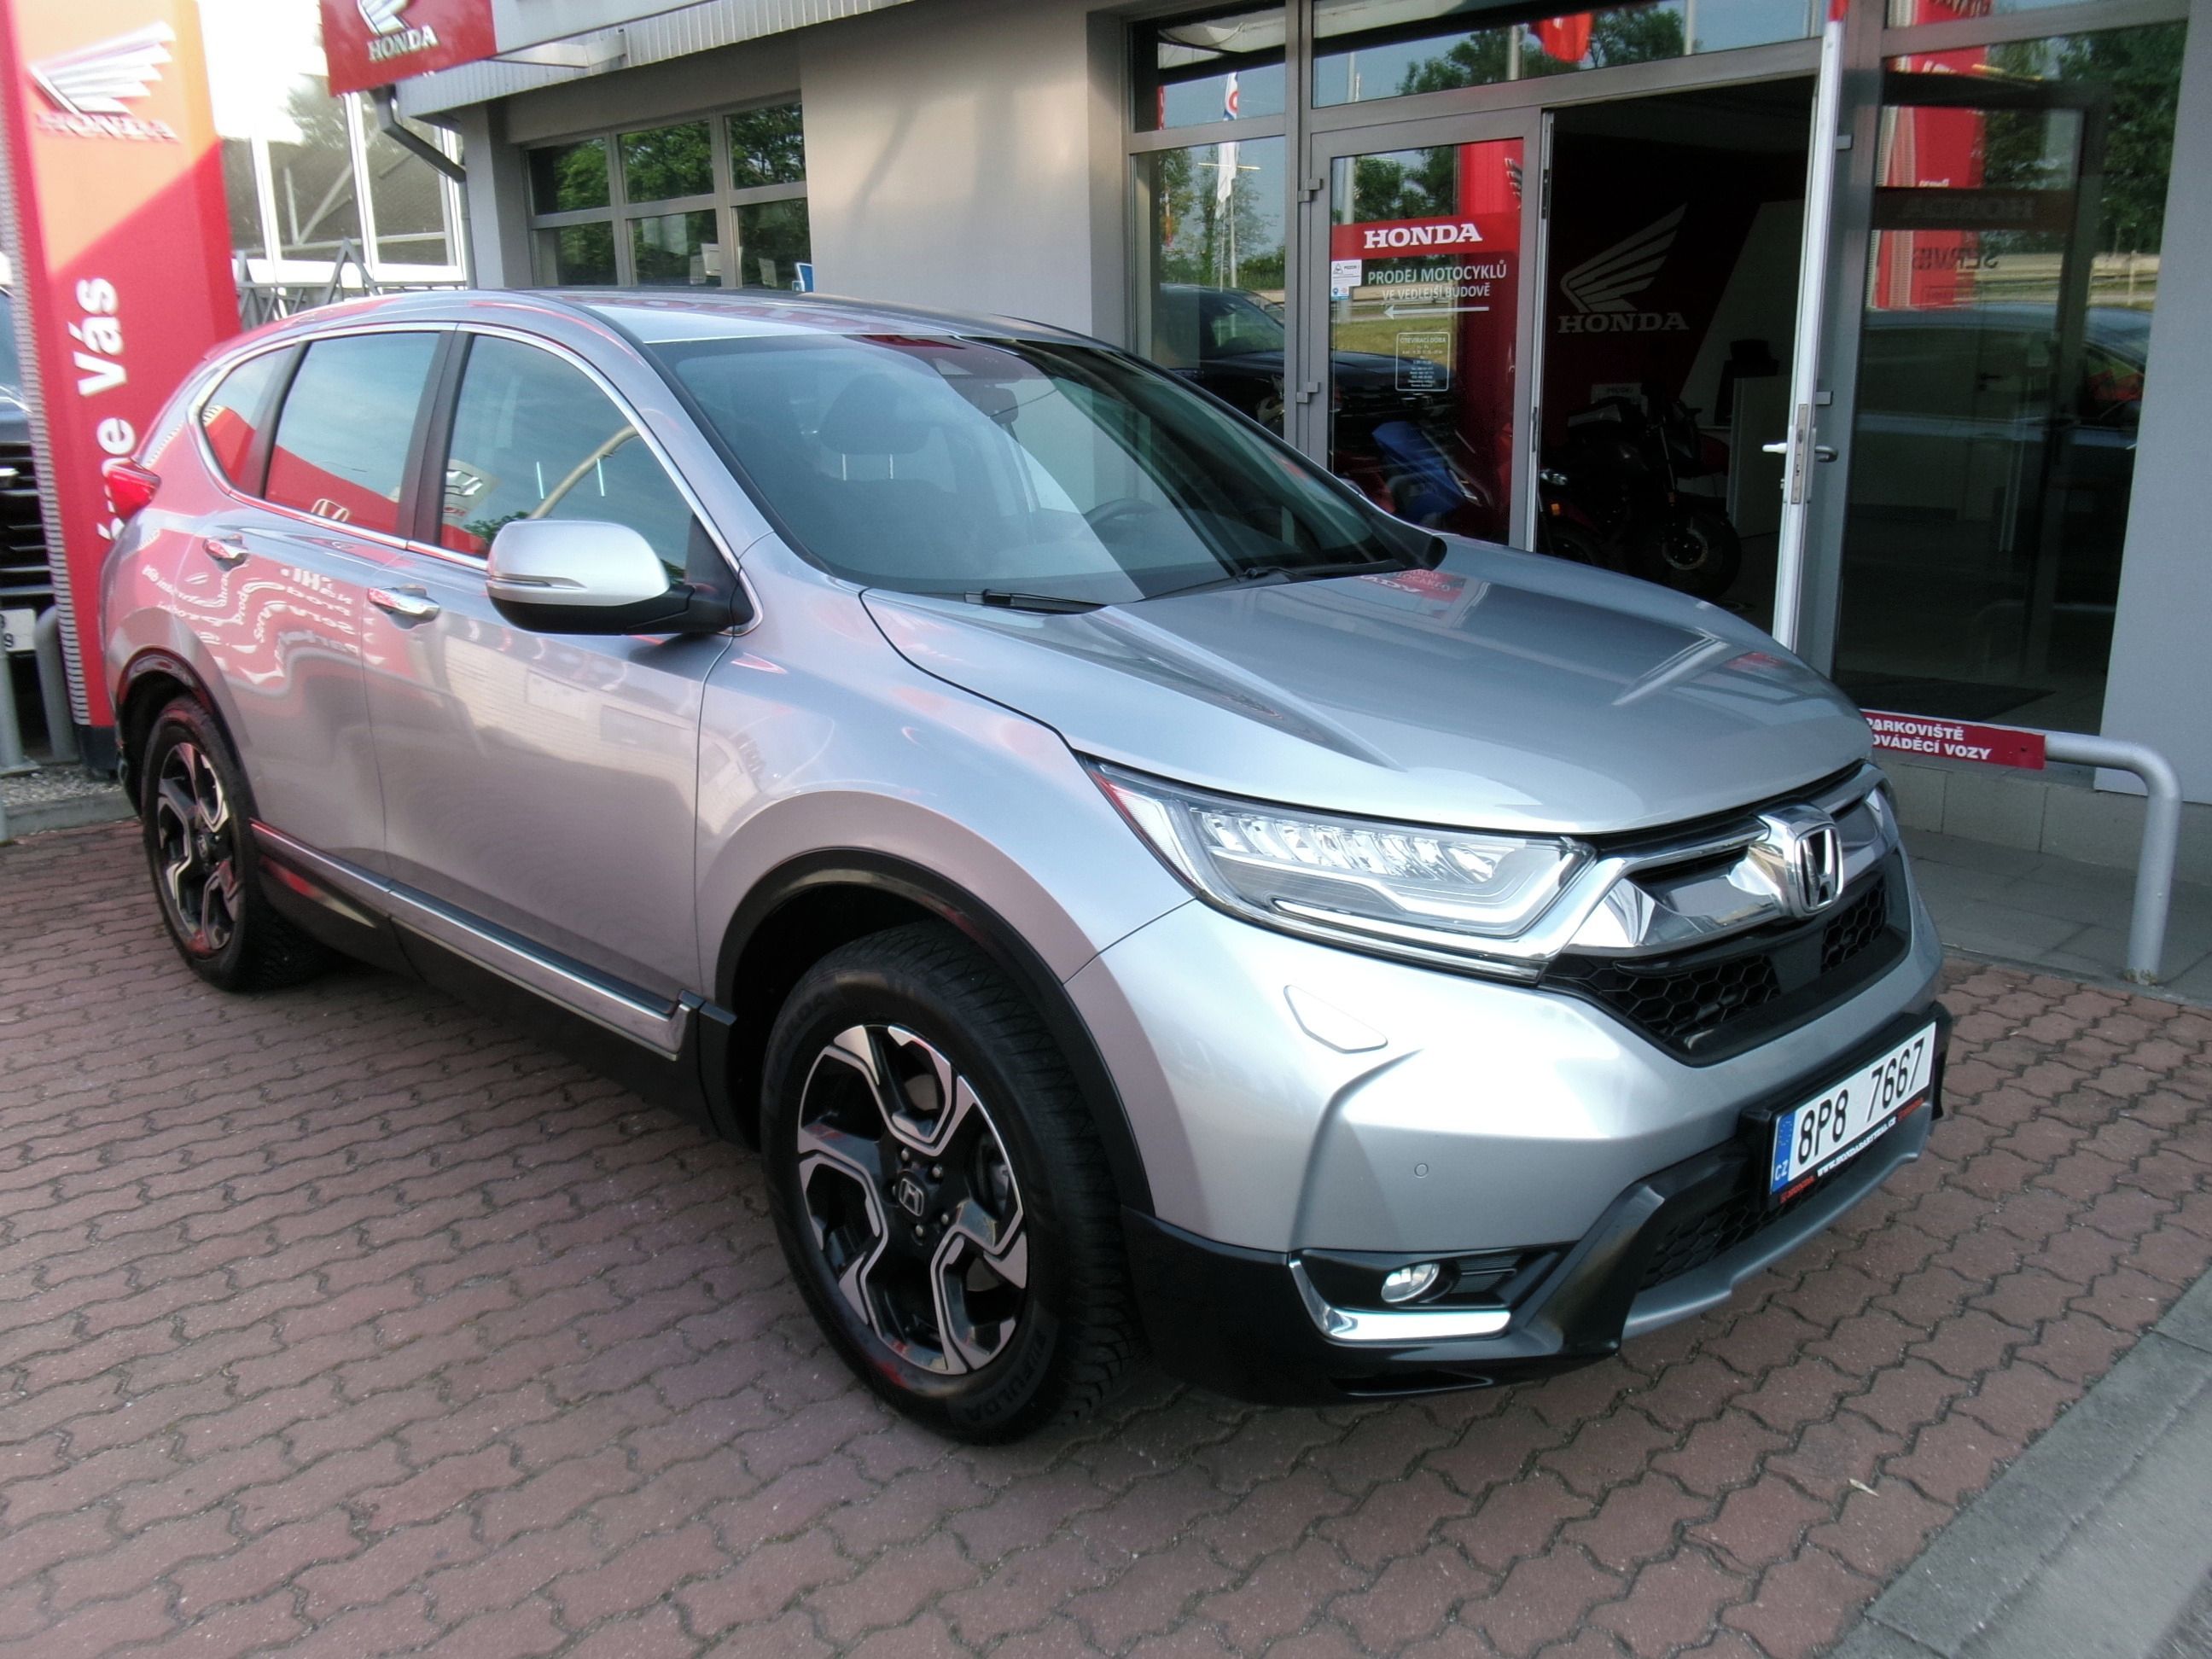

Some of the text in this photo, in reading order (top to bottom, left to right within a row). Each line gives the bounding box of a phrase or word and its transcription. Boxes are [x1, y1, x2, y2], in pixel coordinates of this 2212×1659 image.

[367, 25, 440, 62] HONDA
[1363, 223, 1483, 249] HONDA
[1368, 268, 1417, 285] PRODEJ
[1421, 259, 1507, 282] MOTOCYKLŮ
[1382, 288, 1395, 300] VE
[1446, 282, 1490, 297] BUDOVĚ
[1557, 312, 1690, 334] HONDA
[68, 277, 127, 397] Vás
[1944, 743, 1993, 760] VOZY
[1774, 1159, 1789, 1181] CZ
[1797, 1089, 1848, 1166] 8P8
[1866, 1037, 1925, 1123] 7667
